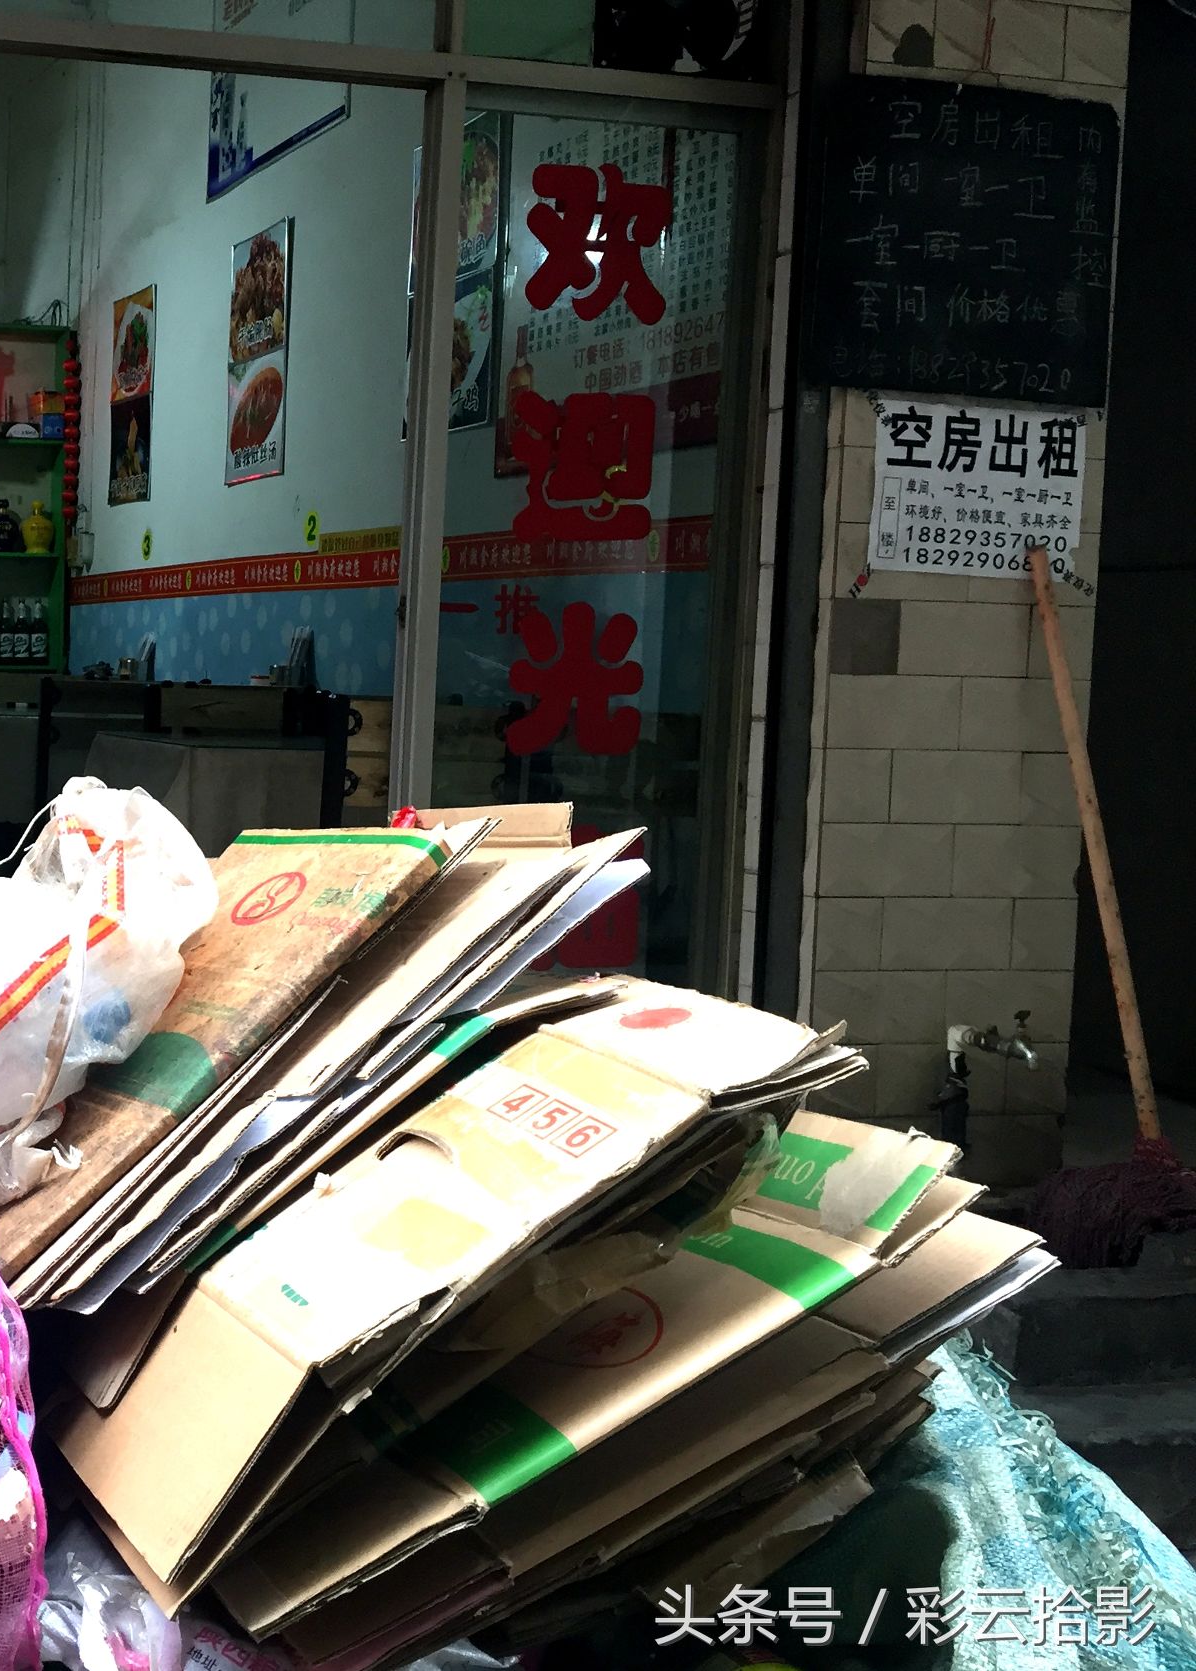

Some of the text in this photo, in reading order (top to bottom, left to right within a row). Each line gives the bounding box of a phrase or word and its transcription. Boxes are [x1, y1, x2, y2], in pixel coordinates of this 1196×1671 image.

[888, 97, 1064, 158] 空房出租
[887, 406, 1079, 478] 空房出租
[904, 547, 1065, 574] 1829290680
[502, 1093, 601, 1148] 456
